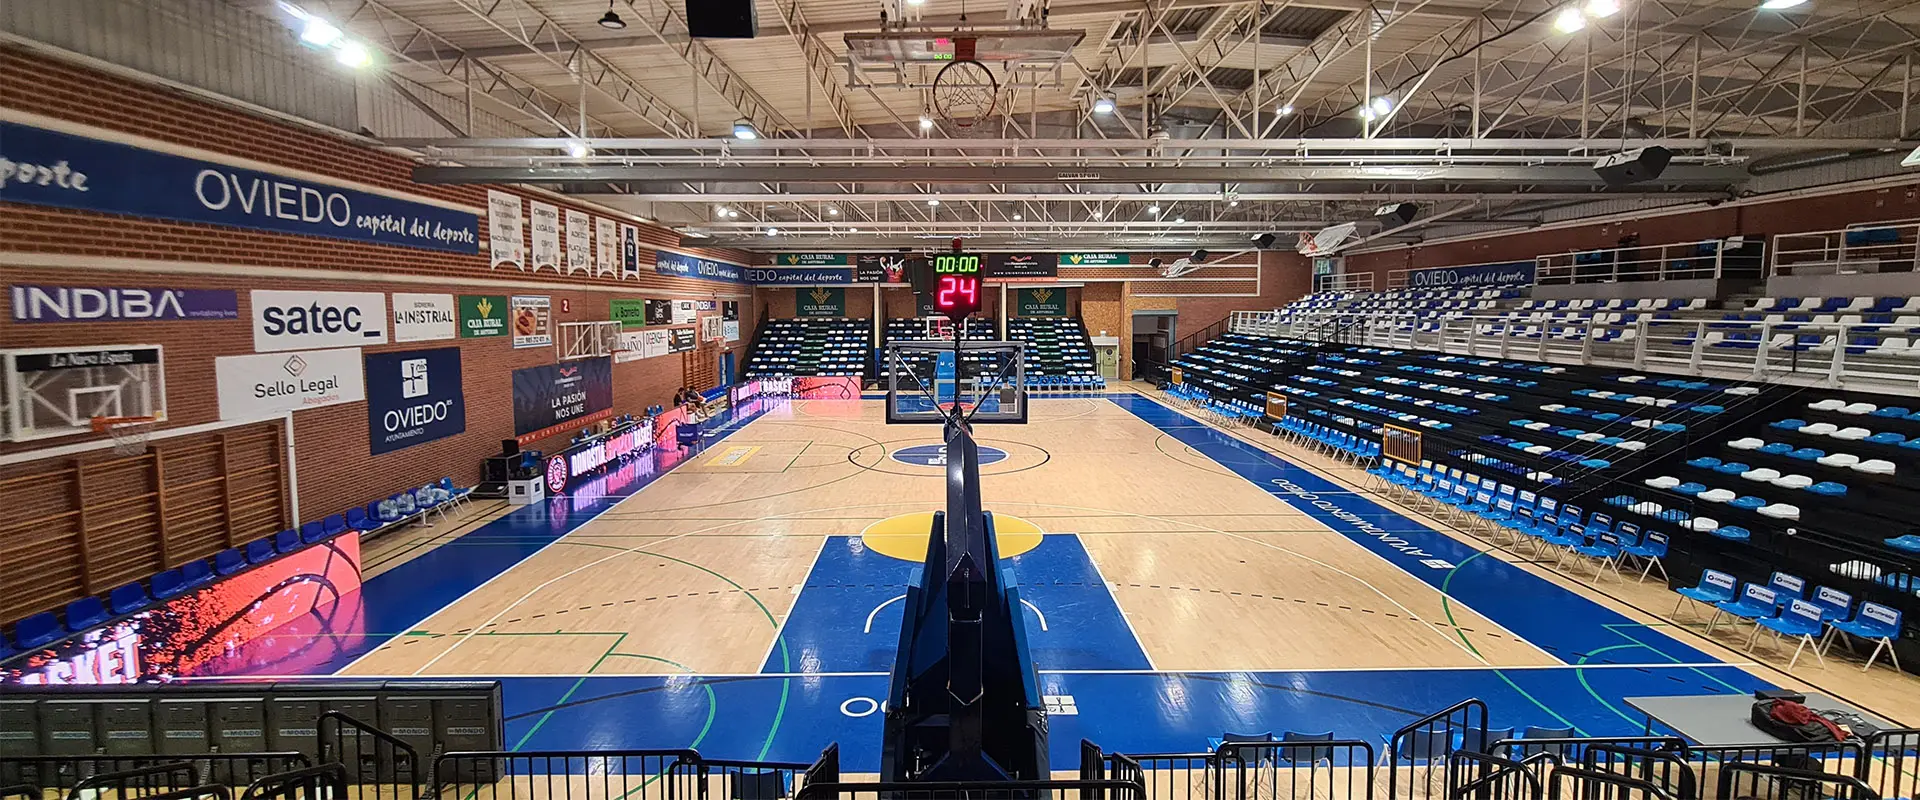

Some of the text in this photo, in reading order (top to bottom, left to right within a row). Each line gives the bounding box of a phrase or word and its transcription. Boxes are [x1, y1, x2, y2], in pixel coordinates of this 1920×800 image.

[195, 169, 475, 245] OVIEDO capital del deporte
[697, 260, 719, 276] OVIEDO
[936, 256, 979, 272] 00:00
[779, 273, 803, 284] capital
[804, 273, 816, 282] del
[817, 273, 843, 283] deporte
[1415, 270, 1525, 286] OVIEDO capital del deporte
[940, 277, 976, 306] 24
[12, 288, 186, 319] INDIBA
[563, 300, 569, 312] 2
[254, 375, 339, 399] Sello Legal
[763, 379, 792, 393] BASKET
[302, 394, 340, 406] Abogados
[551, 390, 586, 408] LA PASIÓN
[384, 401, 447, 432] OVIEDO
[555, 403, 584, 420] NOS UNE
[385, 428, 424, 443] AYUNTAMIENTO
[571, 444, 606, 477] DONOSTIA
[1271, 478, 1433, 557] AYUNTAMIENTO OVIEDO
